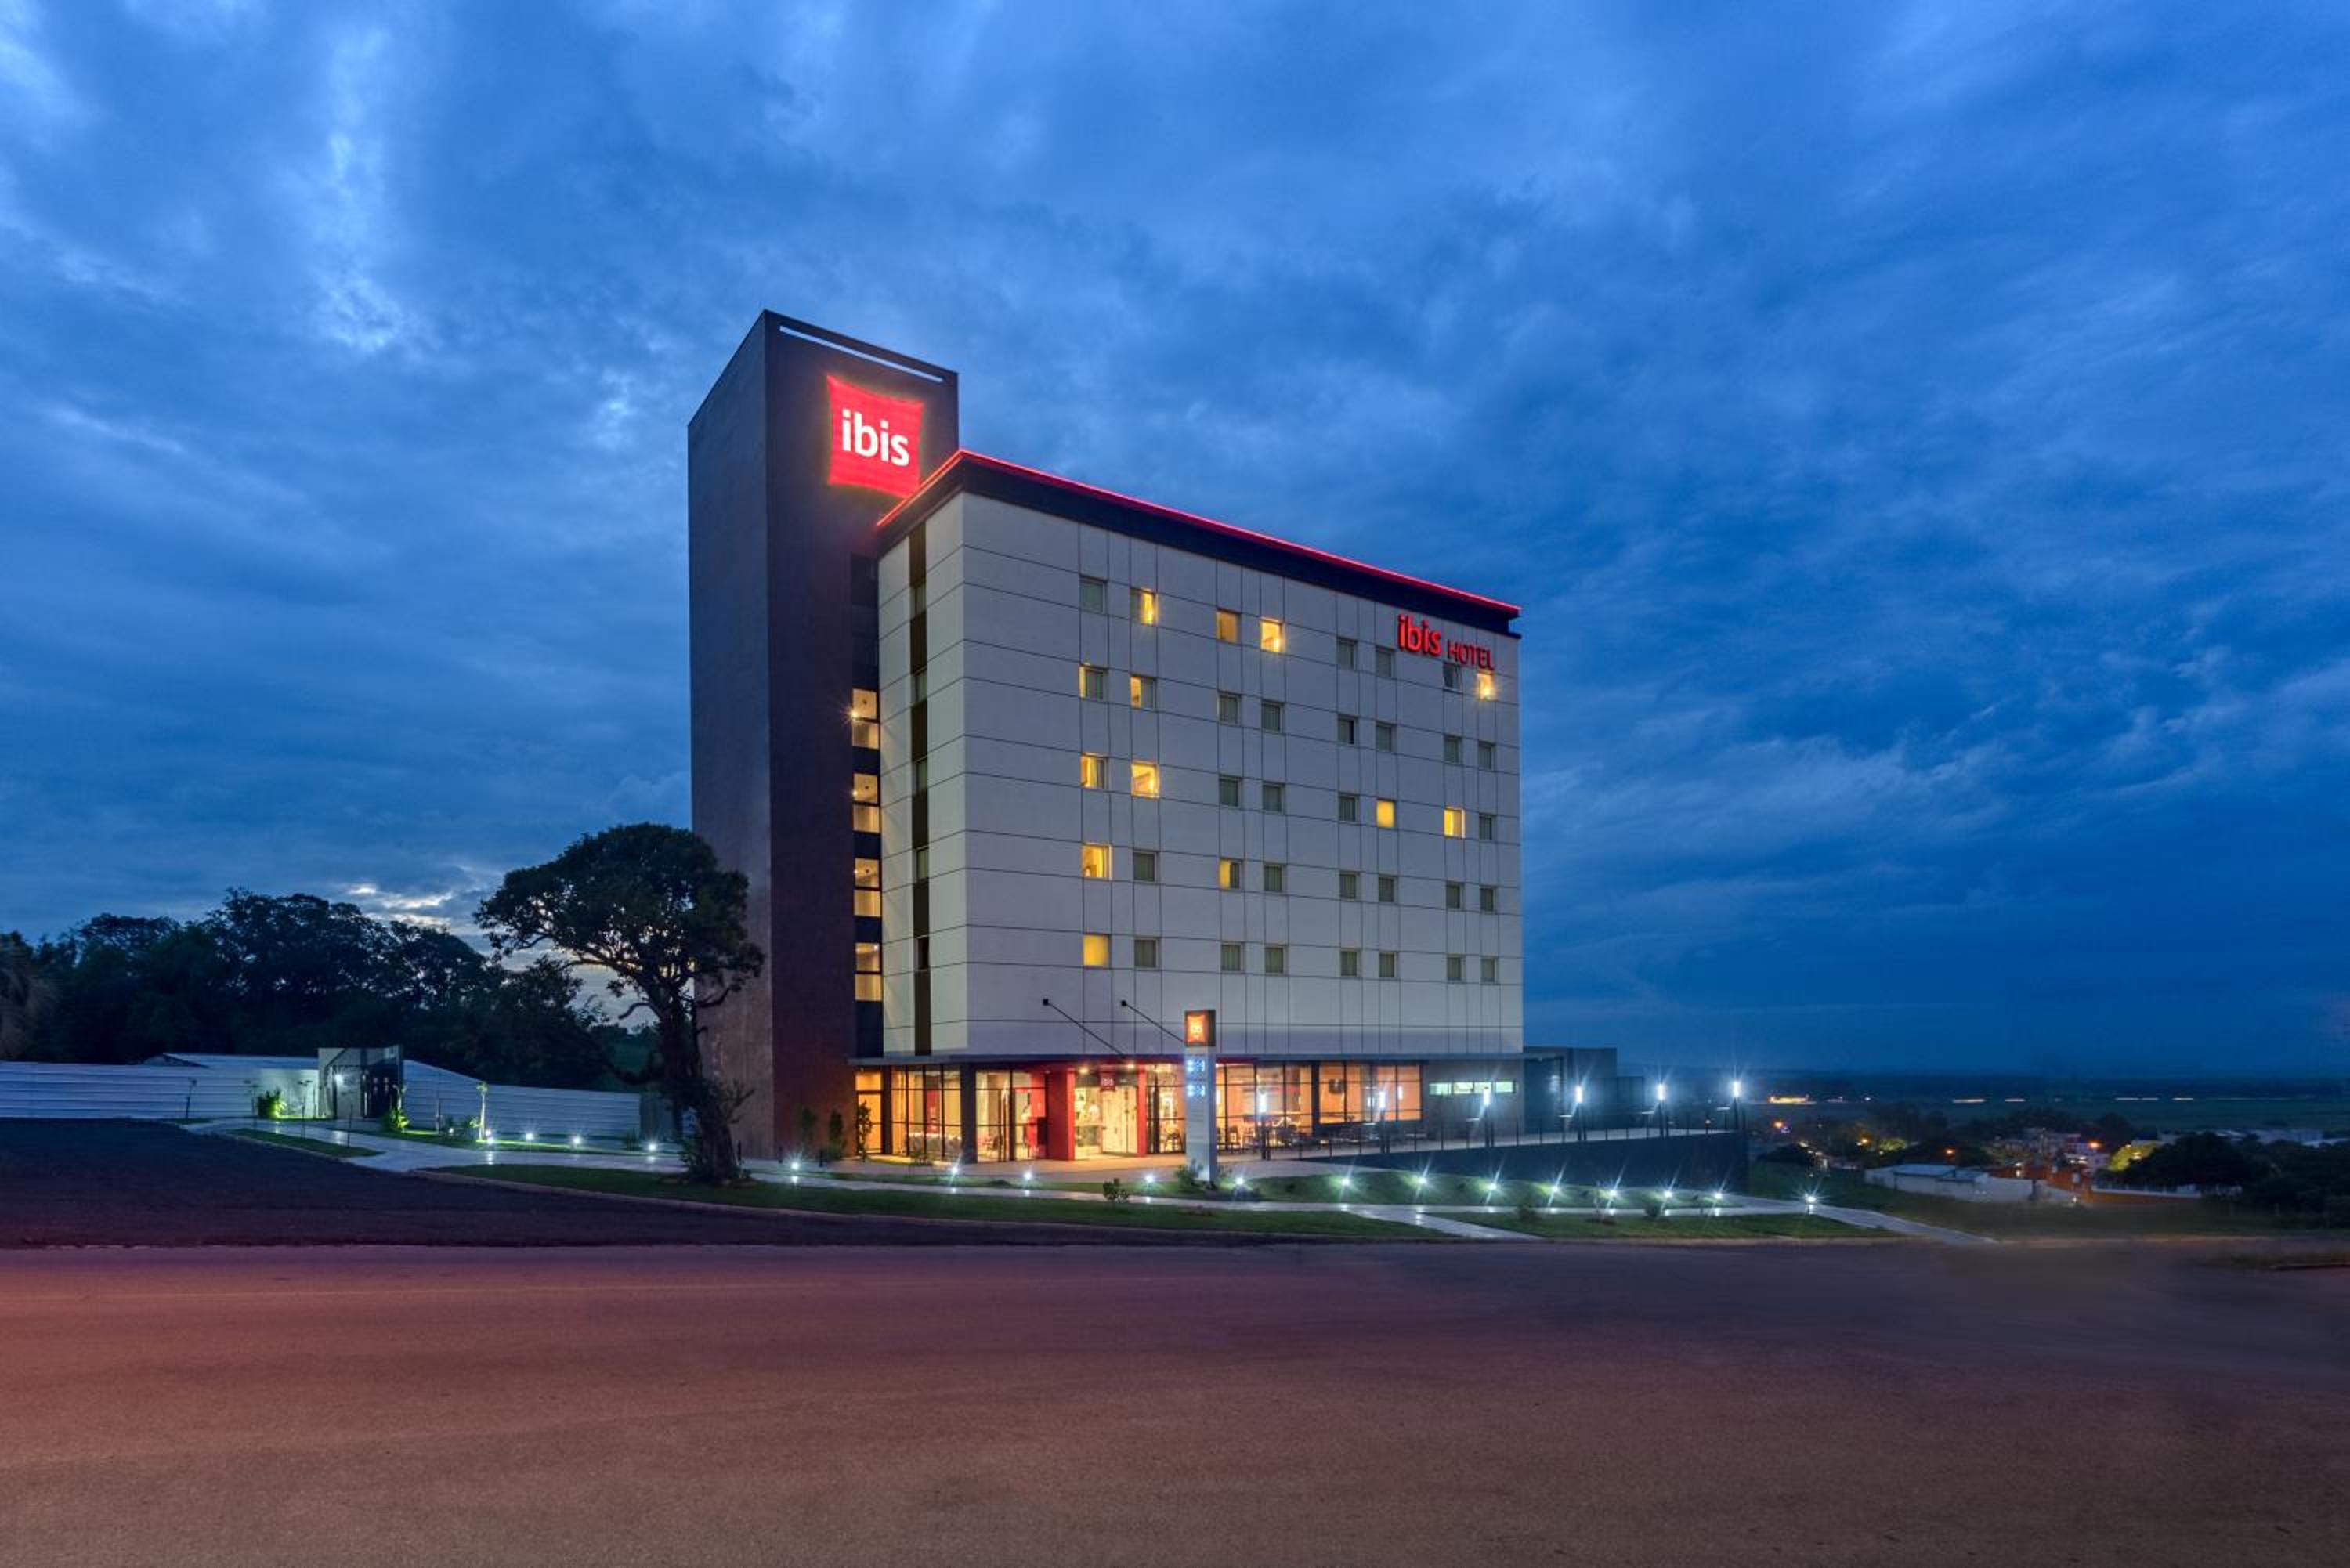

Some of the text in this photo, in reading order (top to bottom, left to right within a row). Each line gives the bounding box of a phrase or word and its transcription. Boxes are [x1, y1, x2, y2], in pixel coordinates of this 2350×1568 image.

[842, 408, 909, 467] ibis
[1397, 613, 1493, 670] ibis HOTEL
